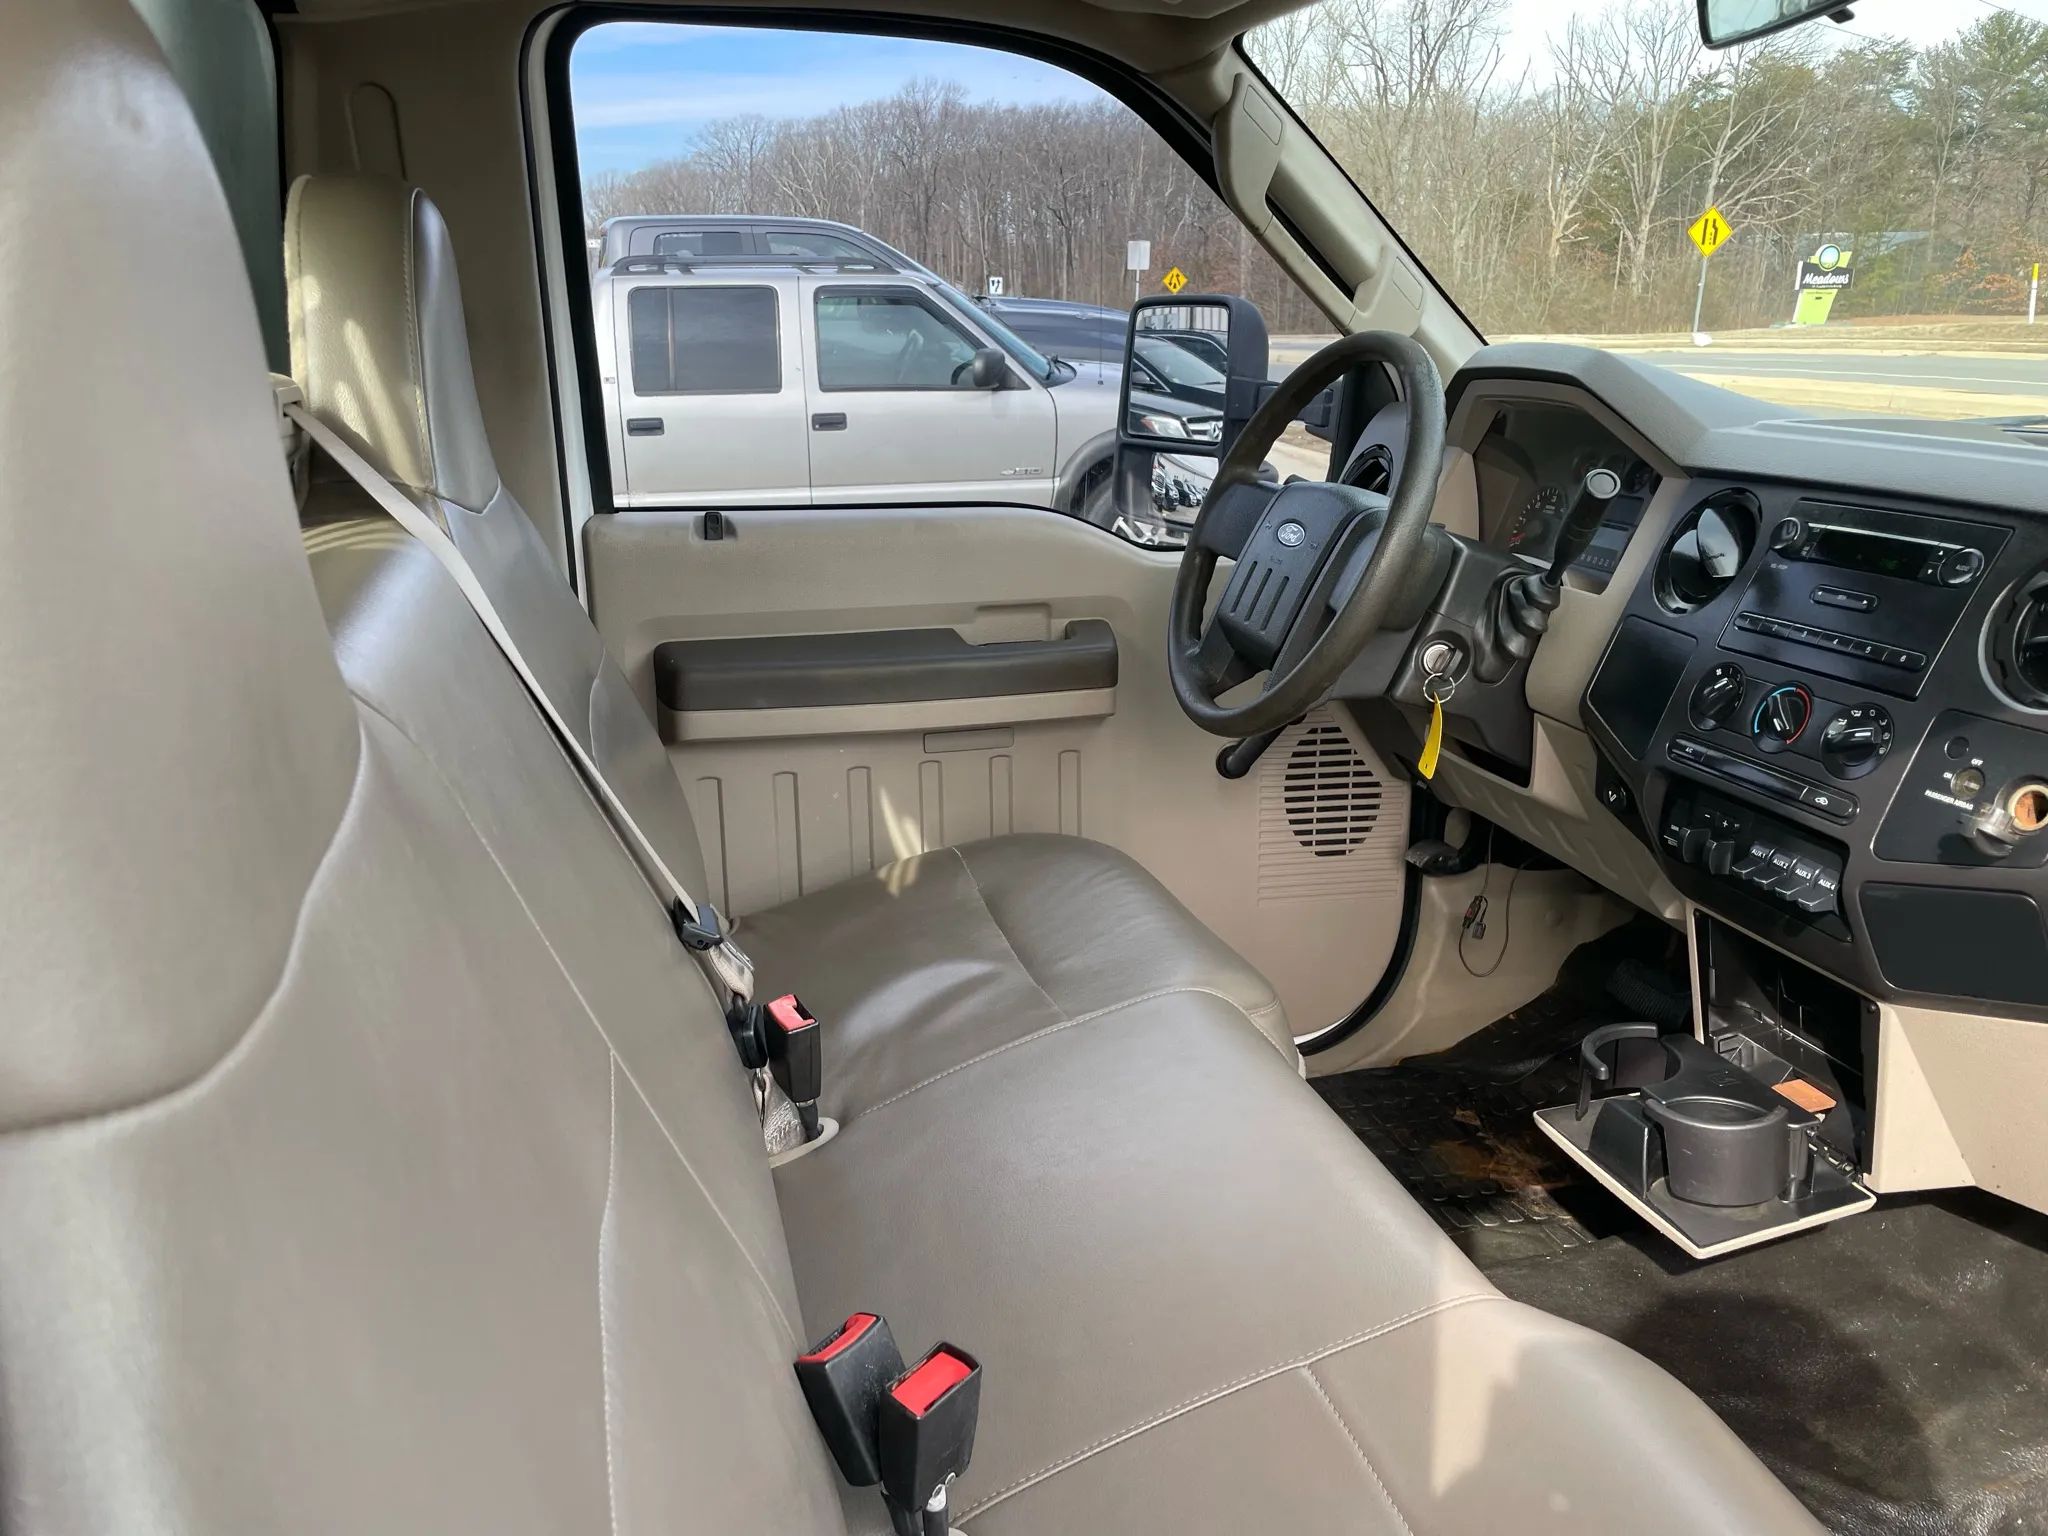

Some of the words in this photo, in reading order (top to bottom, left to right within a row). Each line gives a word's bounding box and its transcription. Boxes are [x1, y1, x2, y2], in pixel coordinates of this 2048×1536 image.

[1802, 272, 1850, 285] Meadows
[1971, 758, 1984, 766] OFF
[1943, 771, 1953, 779] ON
[1751, 848, 1764, 858] AUX
[1772, 858, 1785, 868] AUX
[1795, 868, 1808, 878] AUX
[1817, 879, 1832, 889] AUX
